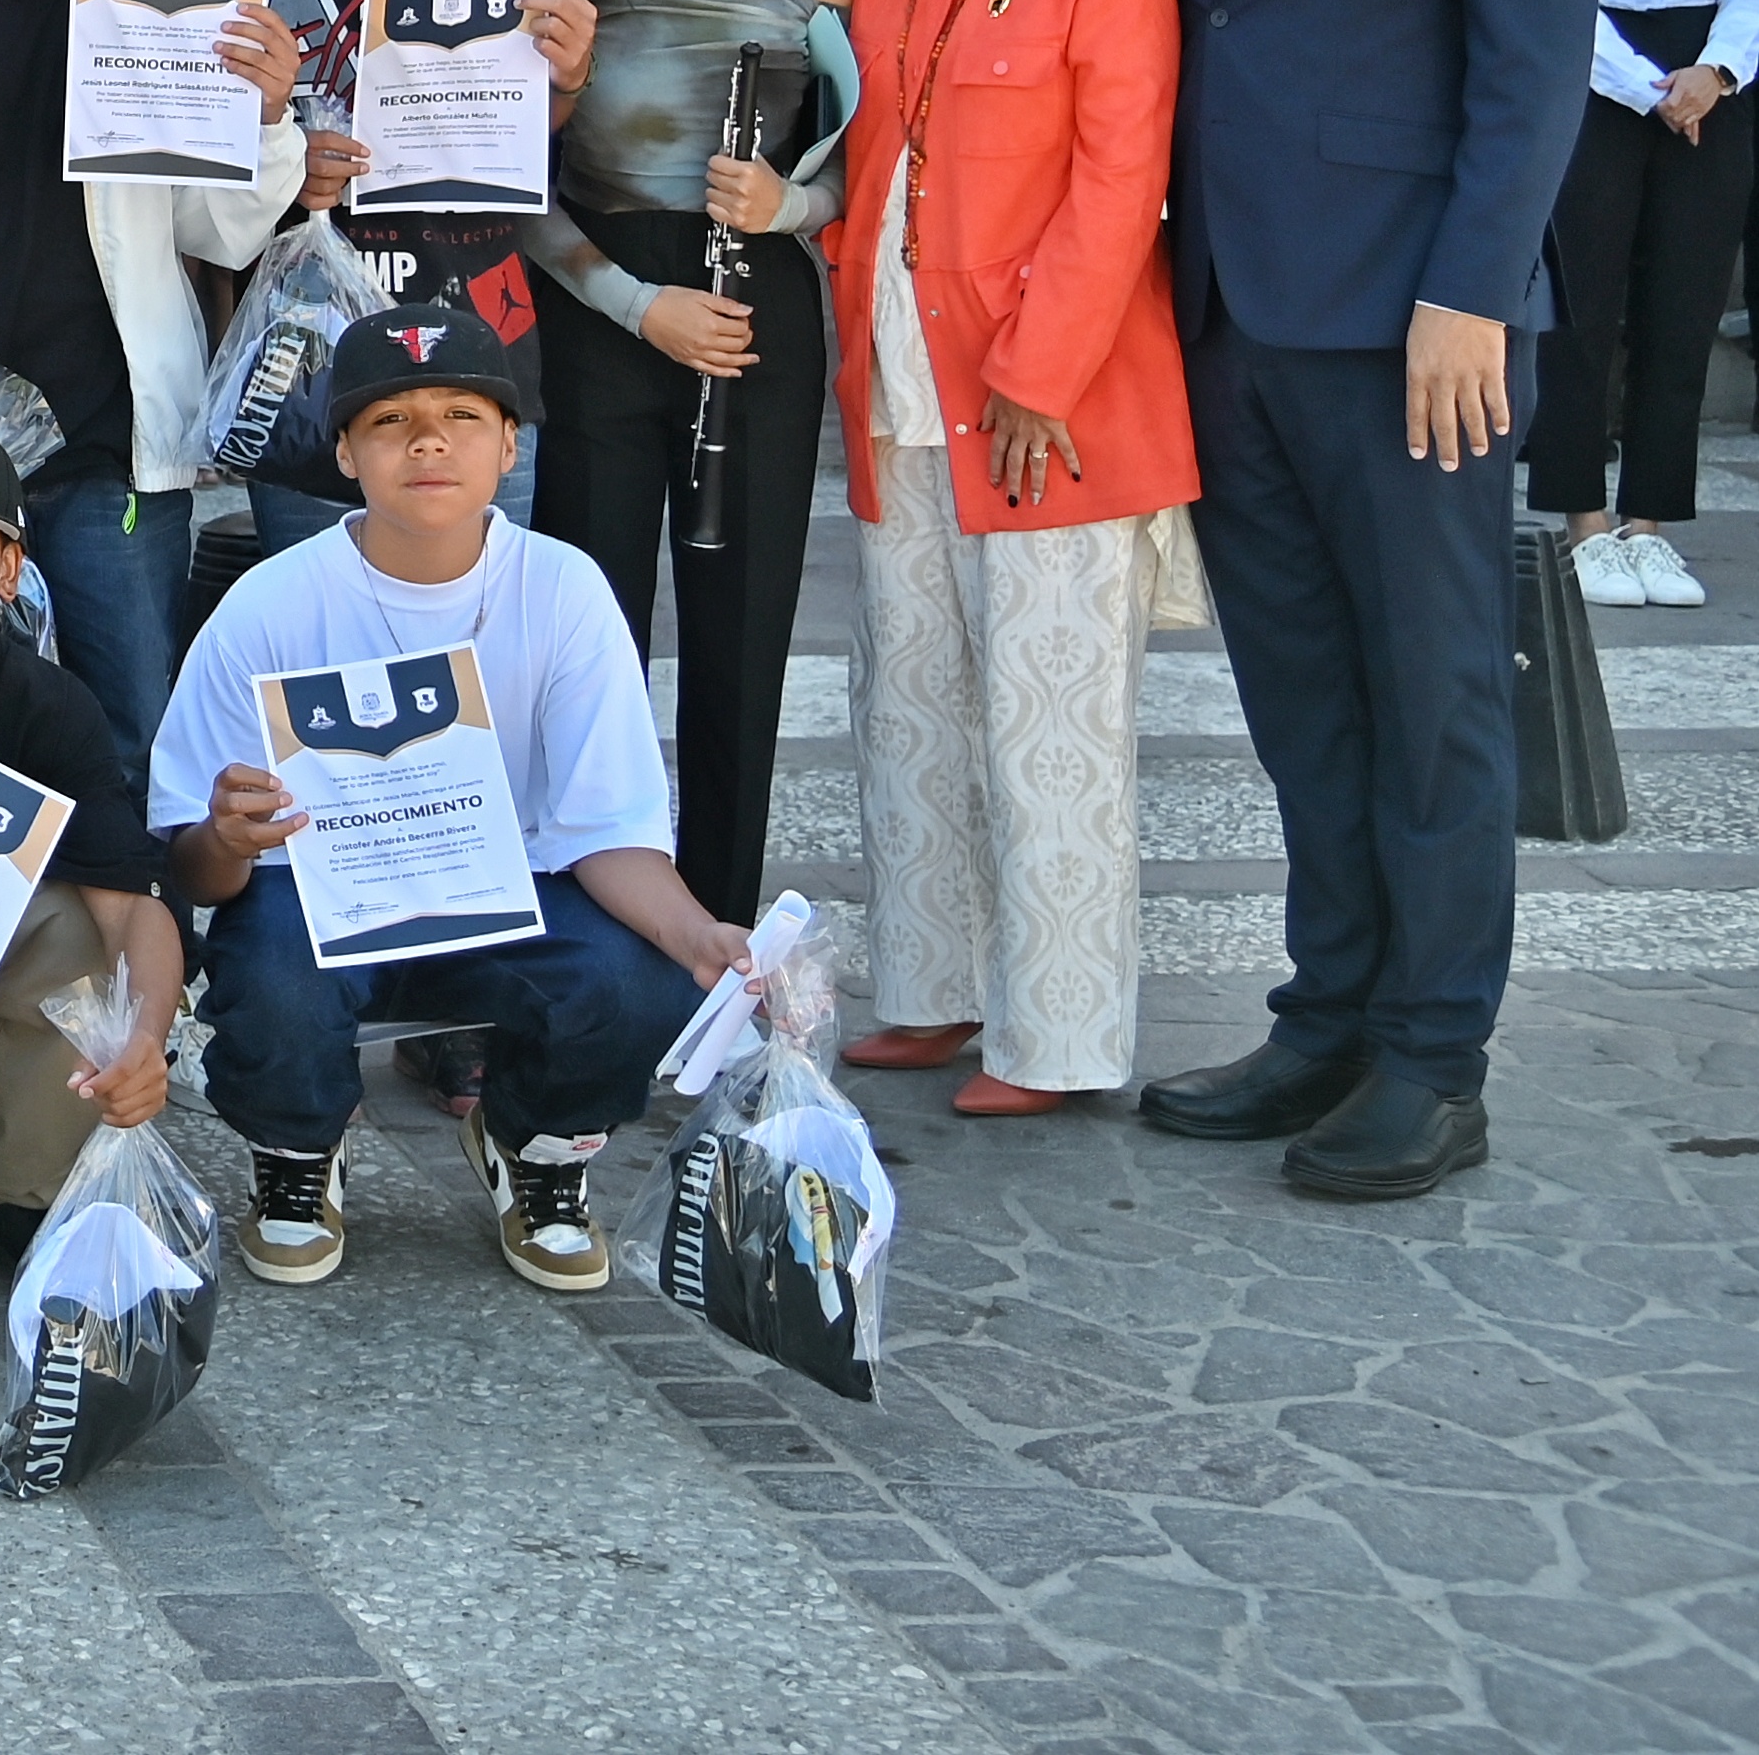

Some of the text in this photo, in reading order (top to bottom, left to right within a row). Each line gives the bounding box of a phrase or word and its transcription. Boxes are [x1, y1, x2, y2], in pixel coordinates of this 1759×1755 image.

[379, 89, 523, 107] RECONOCIMIENTO
[315, 794, 484, 833] RECONOCIMIENTO
[331, 839, 371, 853] Cristofer
[372, 833, 406, 847] Andrés
[445, 822, 477, 835] Rivera
